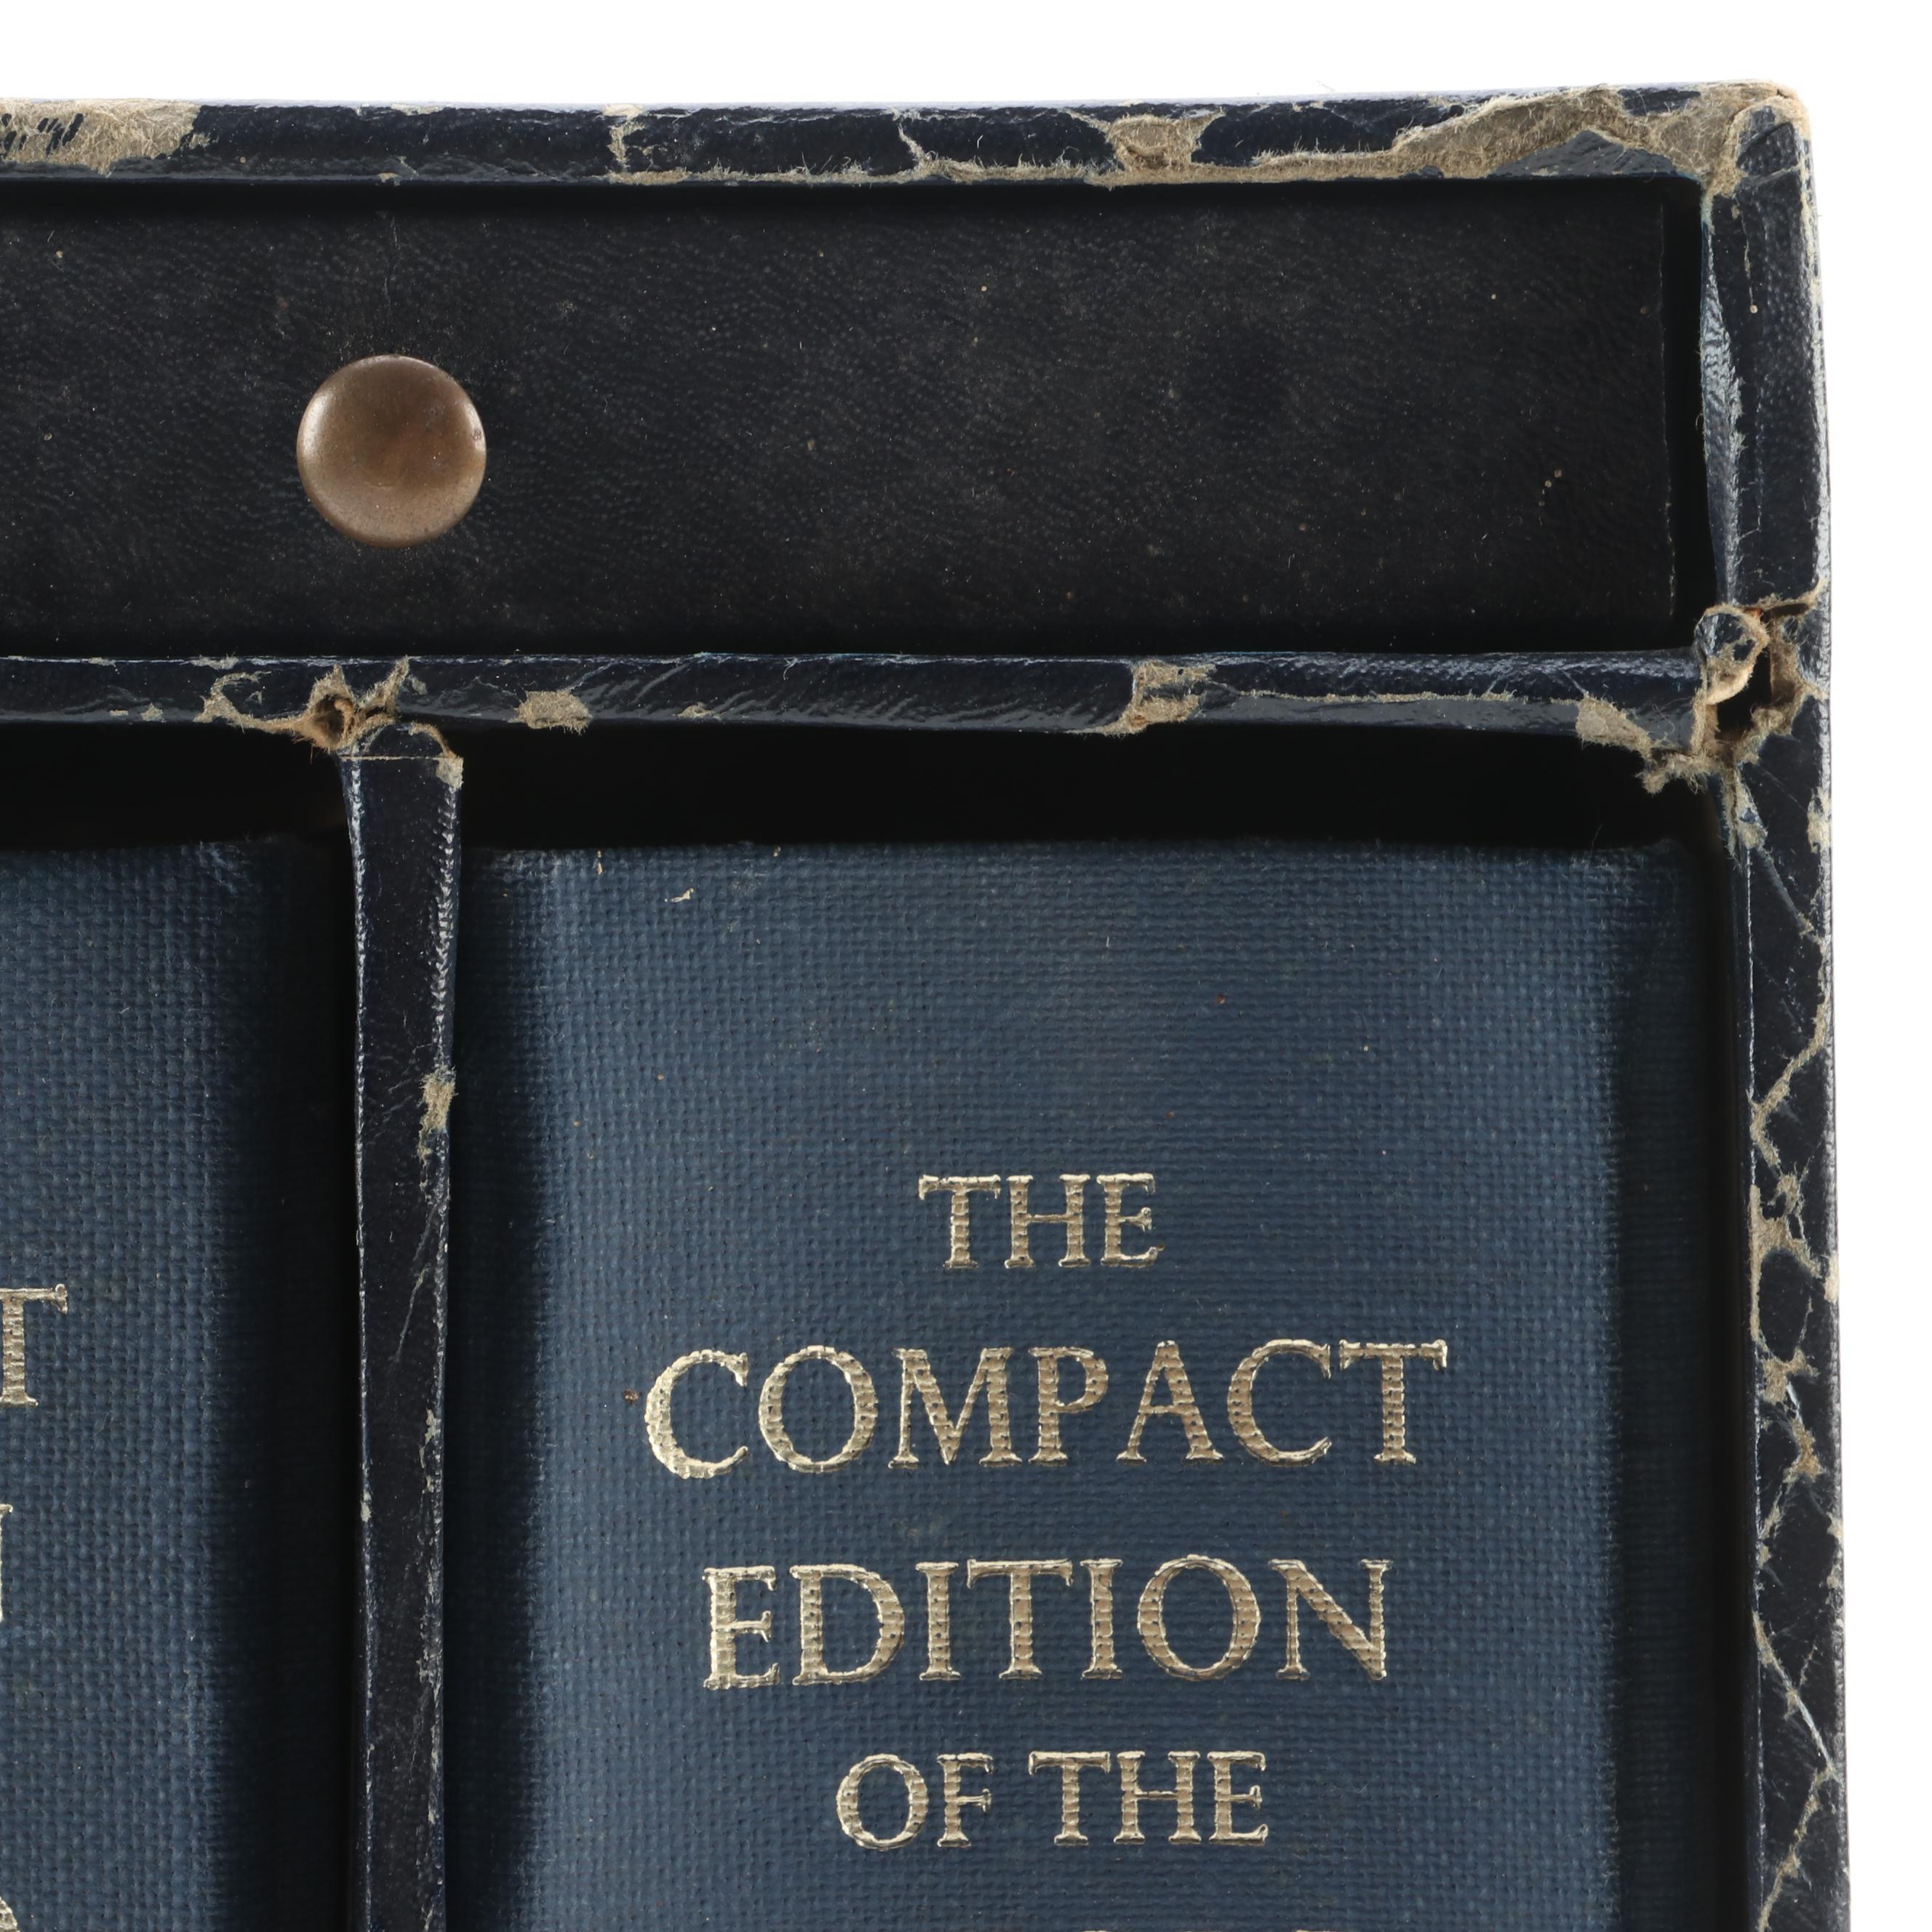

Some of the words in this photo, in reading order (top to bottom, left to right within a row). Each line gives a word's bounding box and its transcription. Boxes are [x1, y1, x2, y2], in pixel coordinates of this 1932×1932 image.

[918, 1173, 1163, 1269] THE
[644, 1339, 1448, 1479] COMPACT
[703, 1554, 1390, 1690] EDITION
[836, 1753, 993, 1851] OF
[1029, 1751, 1268, 1845] THE
